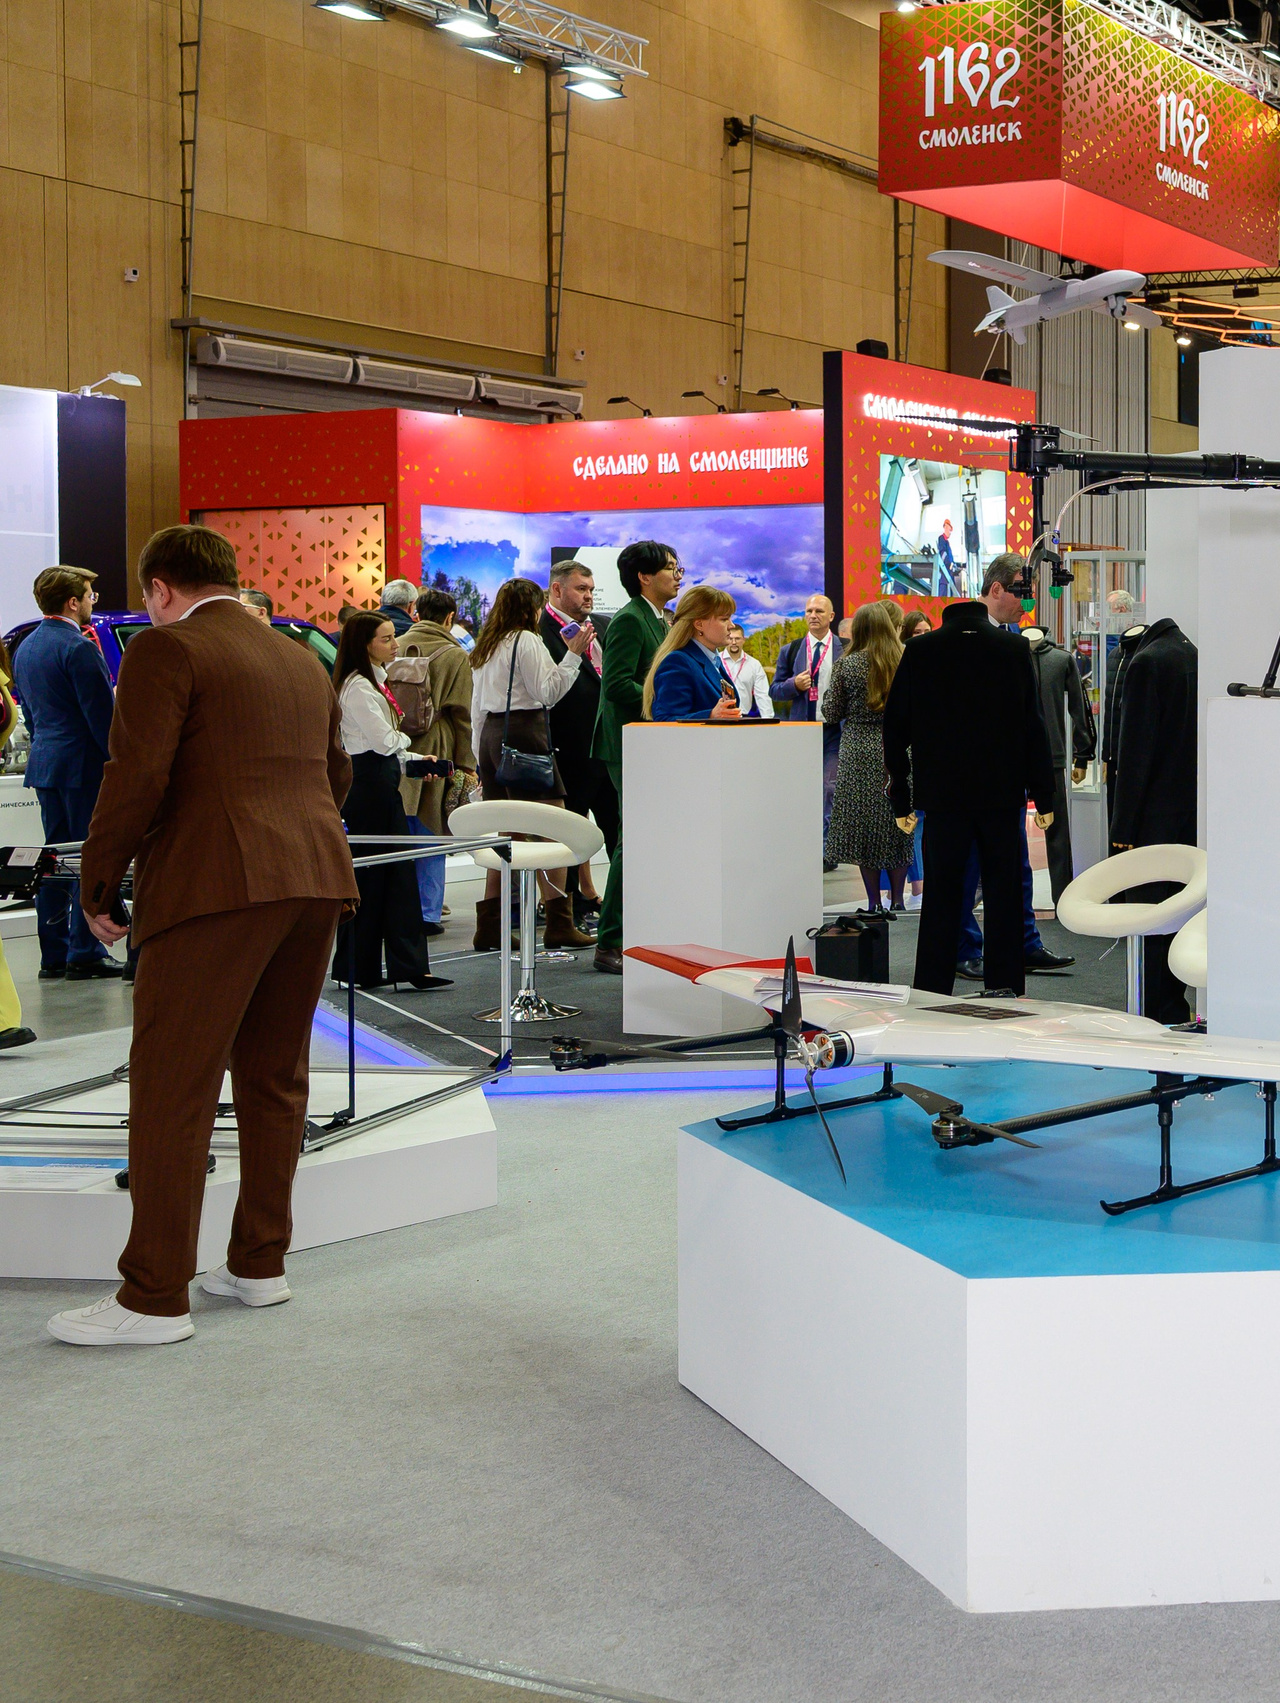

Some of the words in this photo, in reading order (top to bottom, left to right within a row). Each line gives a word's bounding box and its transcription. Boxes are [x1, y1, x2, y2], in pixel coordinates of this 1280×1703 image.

[918, 42, 1020, 117] 1162
[919, 121, 1022, 150] СМОЛЕНСК
[1157, 90, 1209, 170] 1162
[1156, 162, 1209, 201] СМОЛЕНСК
[573, 454, 649, 480] СДЕЛАНО
[658, 452, 680, 473] НА
[690, 446, 809, 473] СМОЛЕНЩИНЕ
